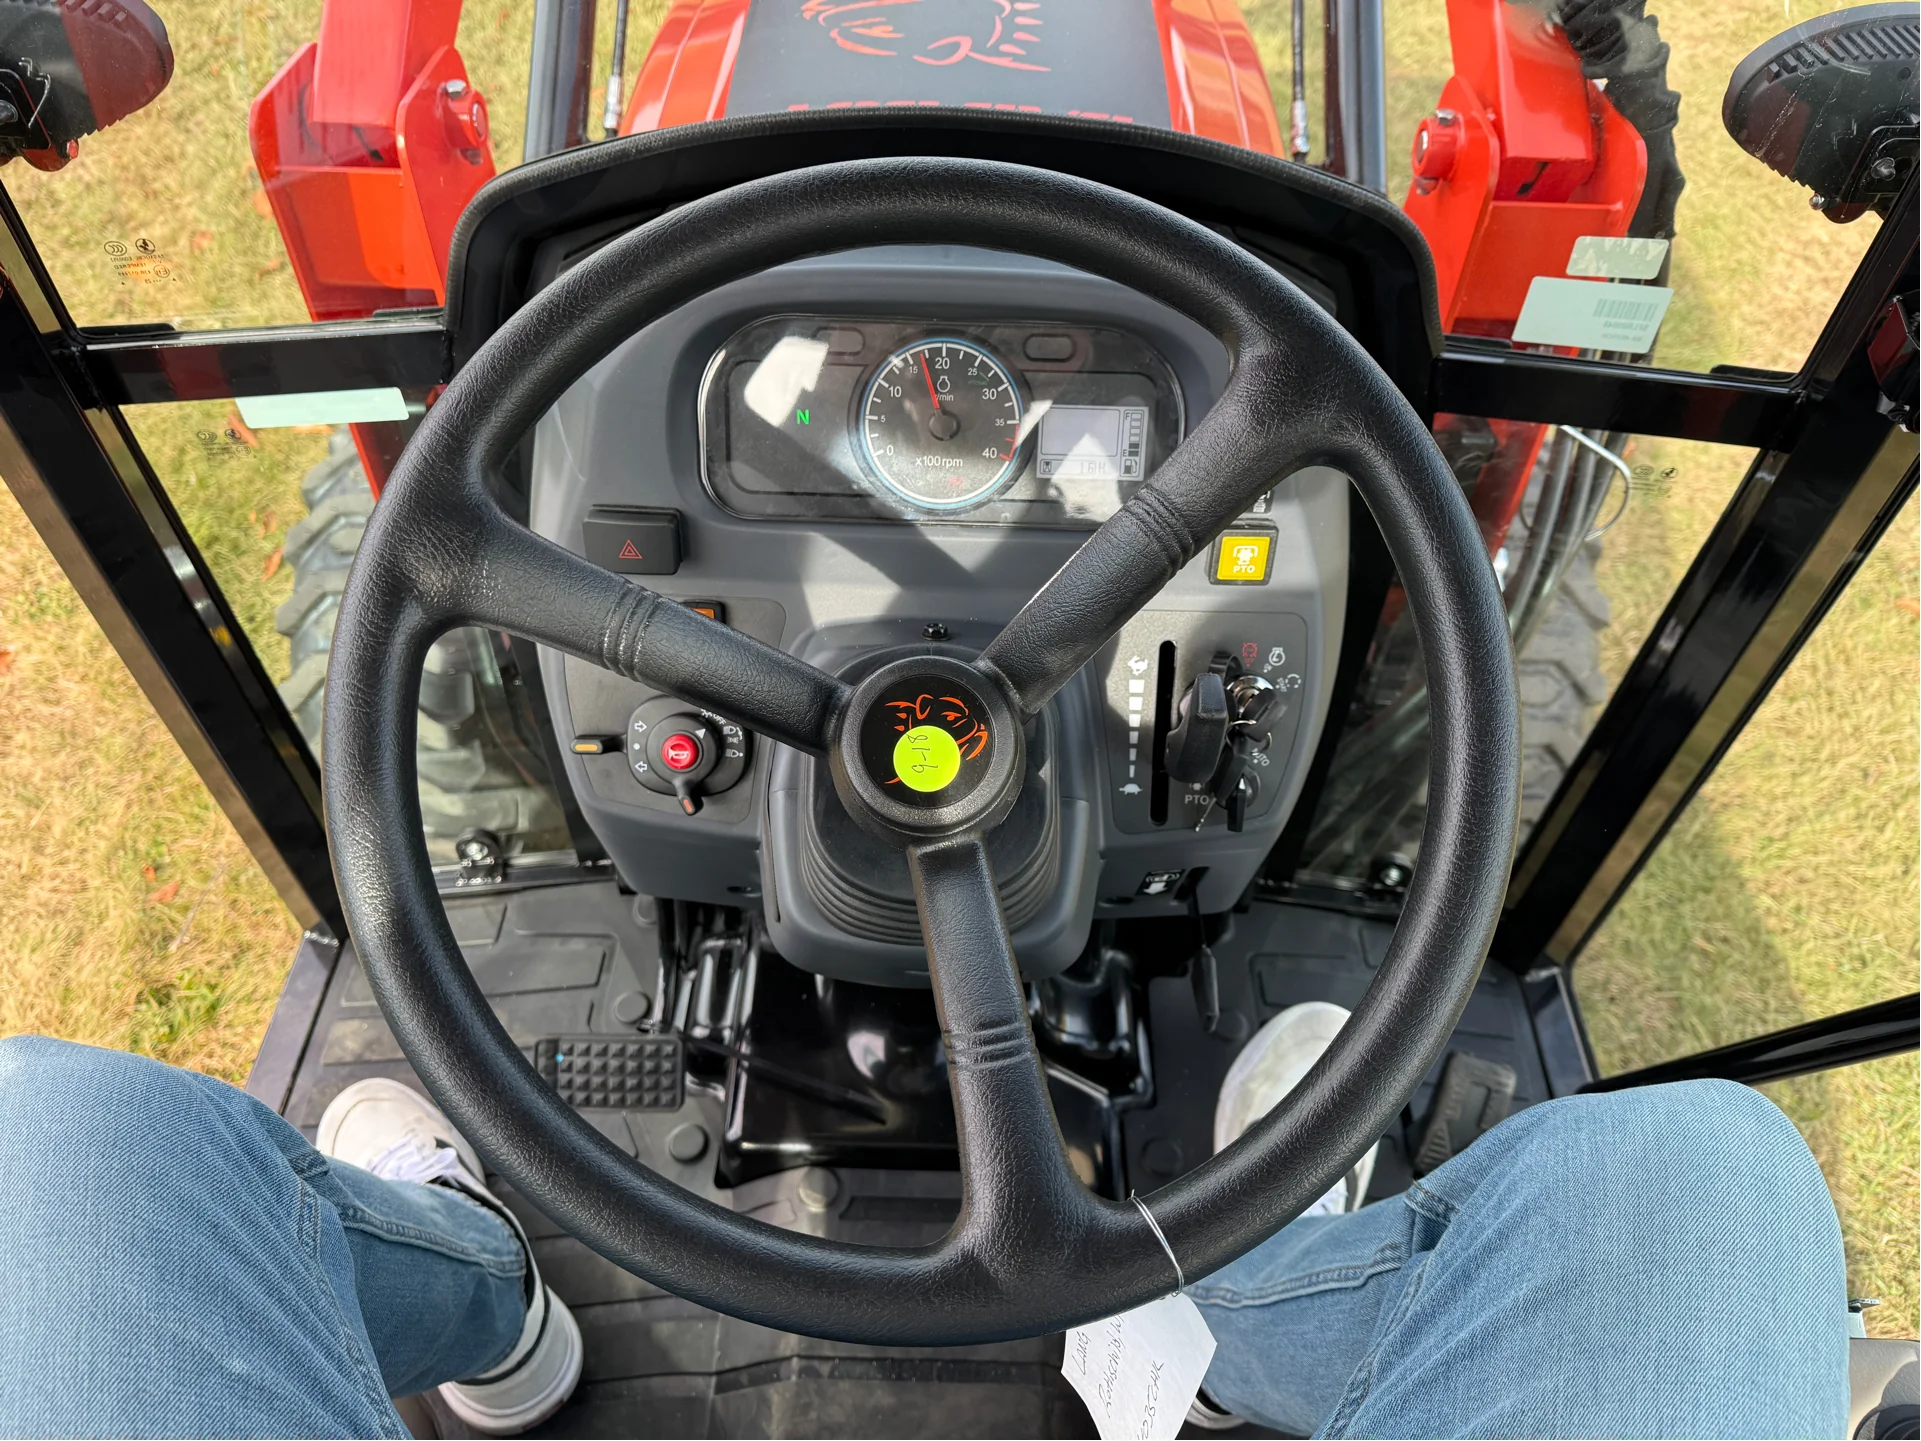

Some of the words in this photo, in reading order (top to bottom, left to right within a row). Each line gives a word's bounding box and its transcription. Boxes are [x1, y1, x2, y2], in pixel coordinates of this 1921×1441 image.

[935, 358, 950, 369] 20
[968, 368, 977, 376] 25
[888, 387, 902, 397] 10
[982, 389, 997, 400] 30
[796, 409, 810, 425] N
[1125, 412, 1130, 420] F
[886, 446, 894, 456] 0
[982, 448, 997, 459] 40
[1123, 449, 1128, 457] E
[915, 455, 941, 467] x100
[942, 458, 963, 469] rpm
[1233, 565, 1256, 574] PTO
[905, 733, 939, 774] 9-18
[1184, 794, 1210, 805] PTO
